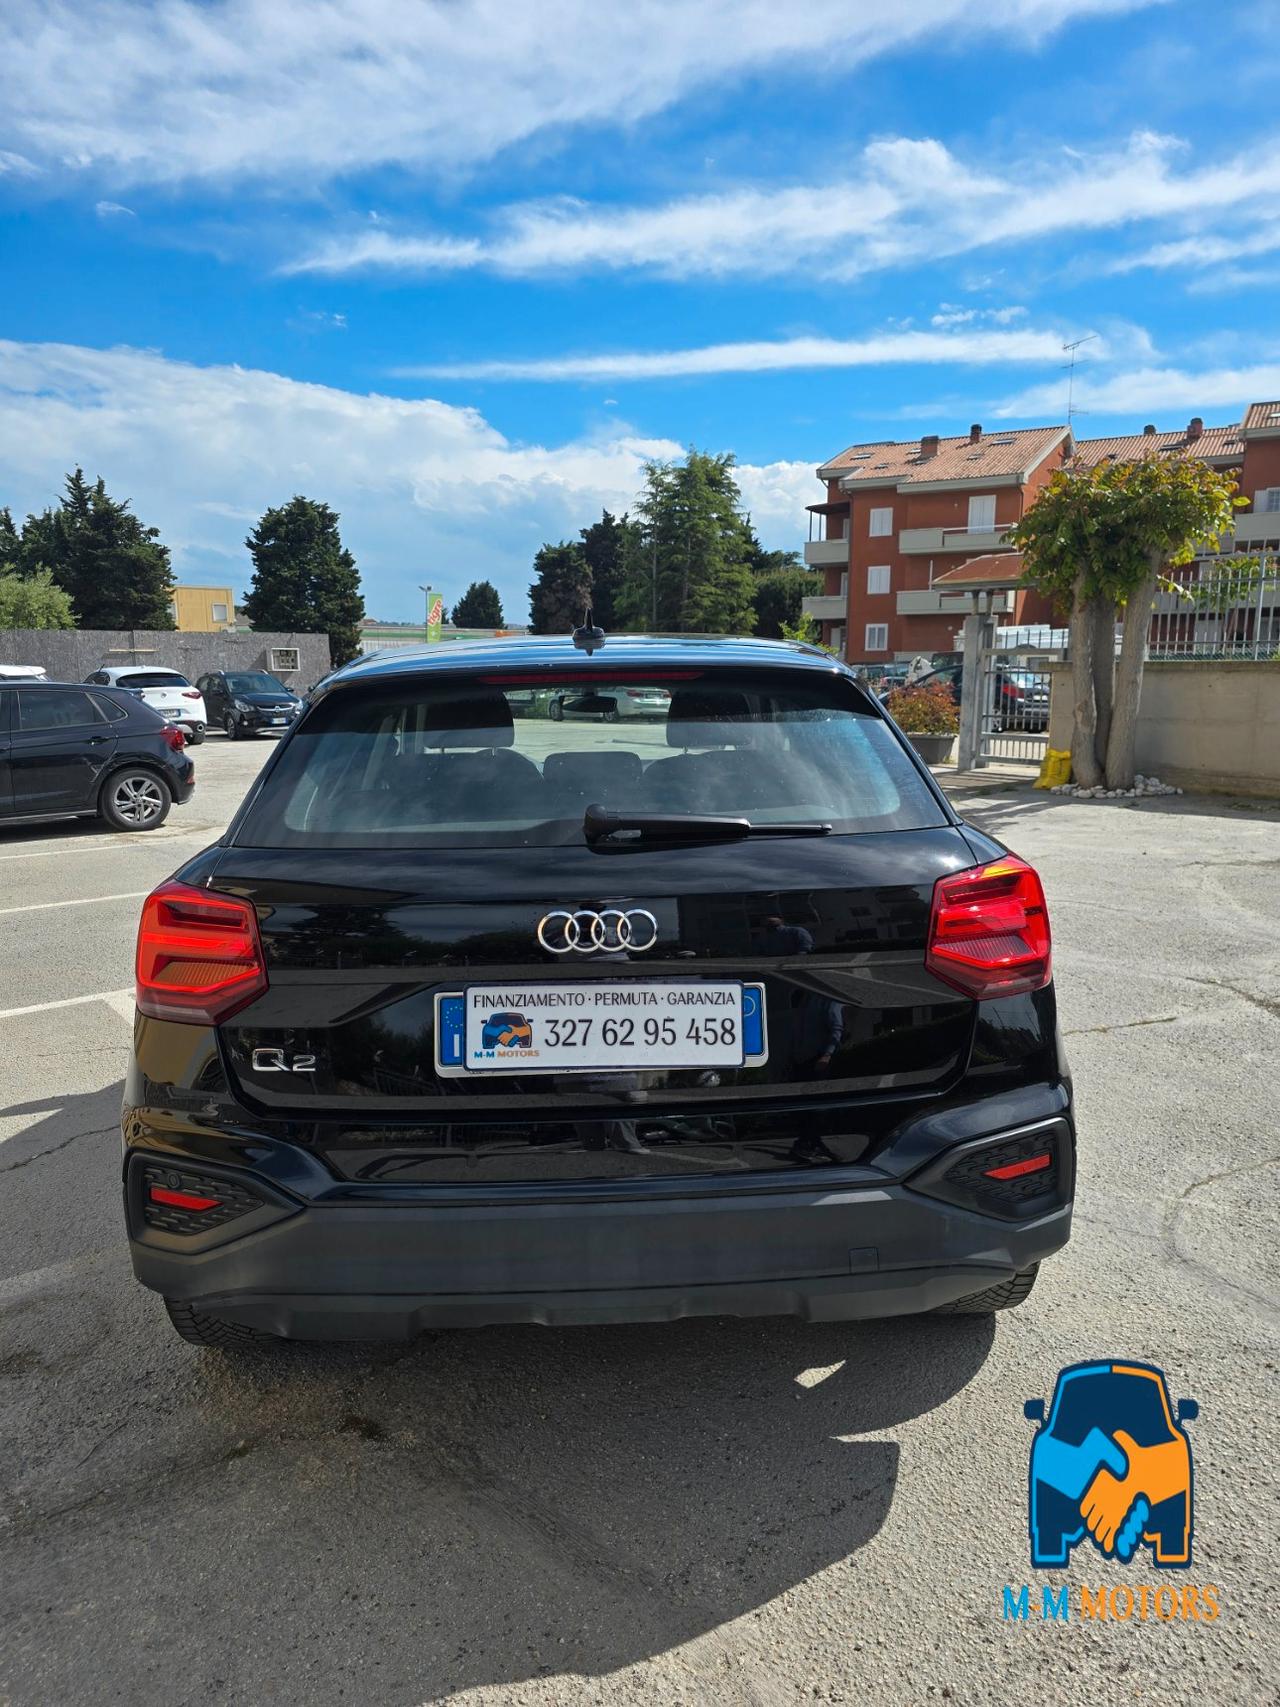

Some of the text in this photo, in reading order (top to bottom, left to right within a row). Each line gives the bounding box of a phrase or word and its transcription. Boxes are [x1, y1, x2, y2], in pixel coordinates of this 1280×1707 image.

[473, 991, 735, 1008] FINANZIAMENTO PERMUTA GARANZIA
[544, 1018, 736, 1047] 327 62 95 458
[252, 1048, 316, 1072] Q2
[497, 1049, 540, 1058] MOTORS
